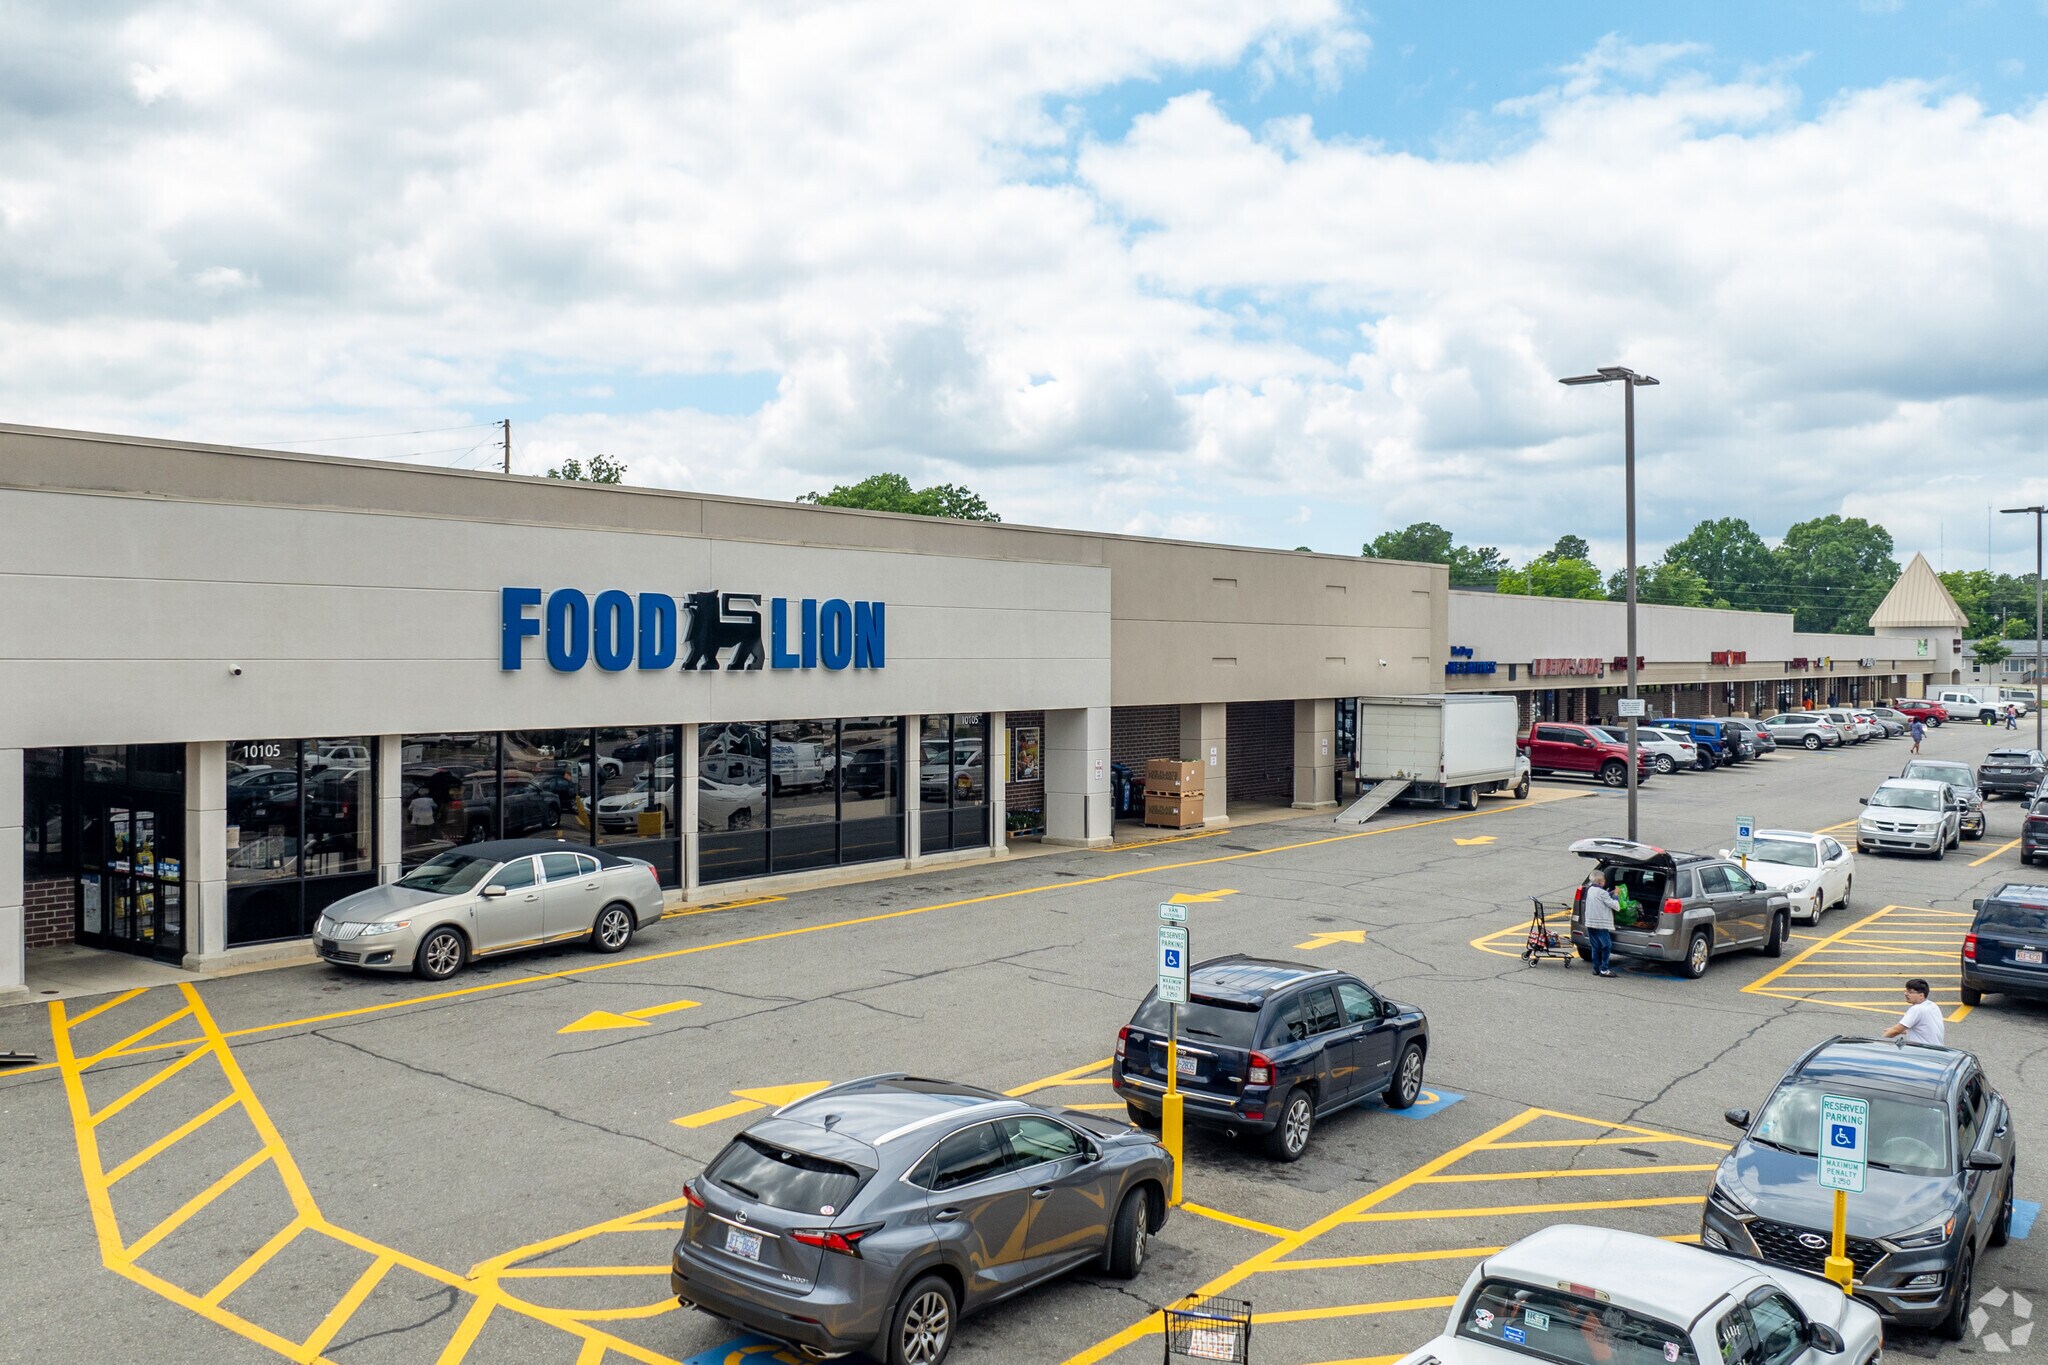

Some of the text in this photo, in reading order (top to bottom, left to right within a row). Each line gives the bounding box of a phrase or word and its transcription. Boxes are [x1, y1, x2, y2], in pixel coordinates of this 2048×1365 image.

[500, 586, 886, 673] FOOD LION
[961, 715, 979, 725] 10105
[243, 744, 281, 758] 10105
[1160, 930, 1185, 940] RESERVED
[1161, 939, 1184, 949] PARKING
[1824, 1100, 1866, 1115] RESERVED
[1825, 1112, 1863, 1125] PARKING
[1826, 1159, 1859, 1170] MAXIMUM
[1826, 1168, 1857, 1179] PENALTY
[1832, 1177, 1851, 1186] $250
